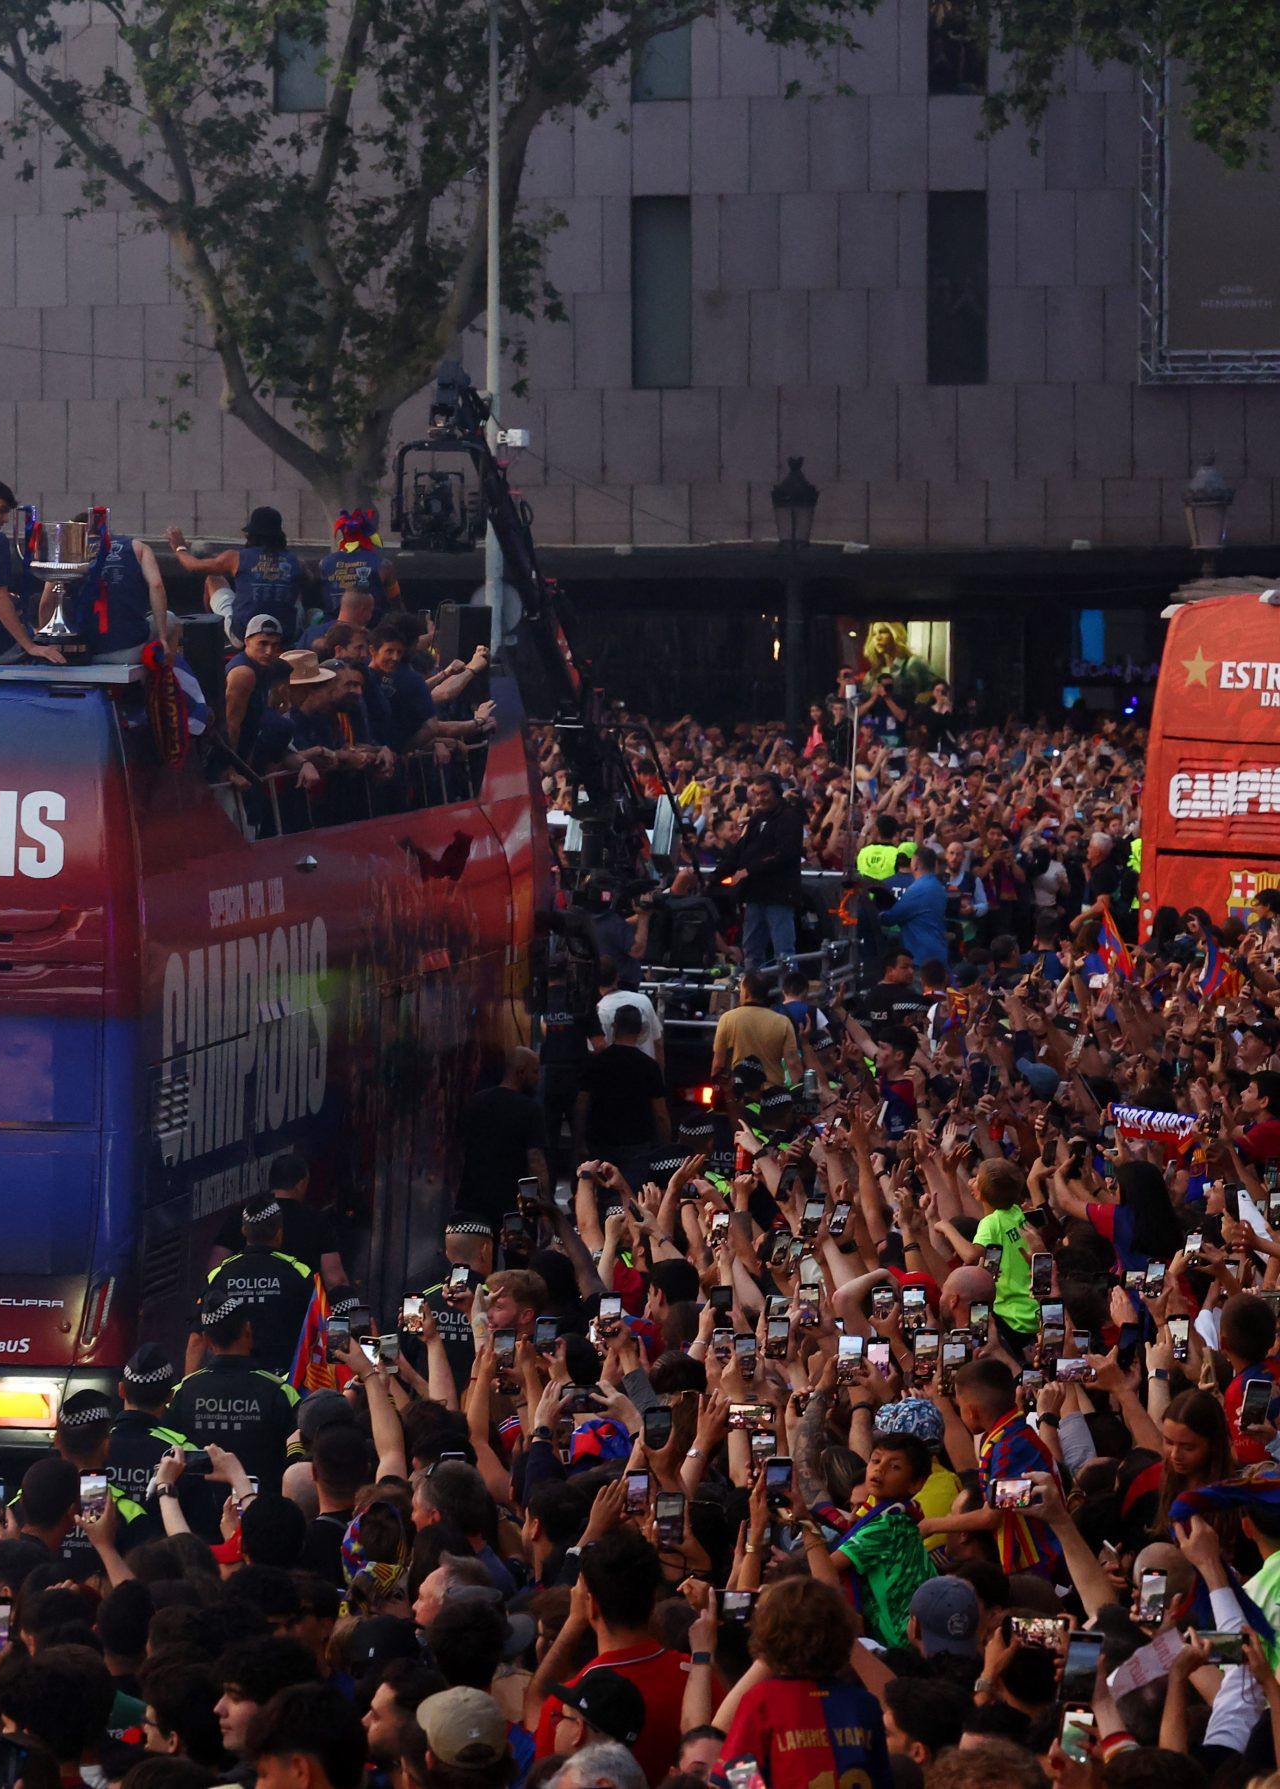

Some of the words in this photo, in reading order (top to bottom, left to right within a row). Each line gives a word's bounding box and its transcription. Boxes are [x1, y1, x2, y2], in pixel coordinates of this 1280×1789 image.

[162, 916, 328, 1168] CAMPIONS
[227, 1278, 280, 1289] POLICIA
[0, 1298, 64, 1308] CUPRA
[431, 1311, 471, 1326] POLIC
[195, 1398, 260, 1412] POLICIA
[195, 1413, 227, 1421] guardia
[230, 1413, 261, 1421] urbana
[104, 1466, 151, 1484] OLICI
